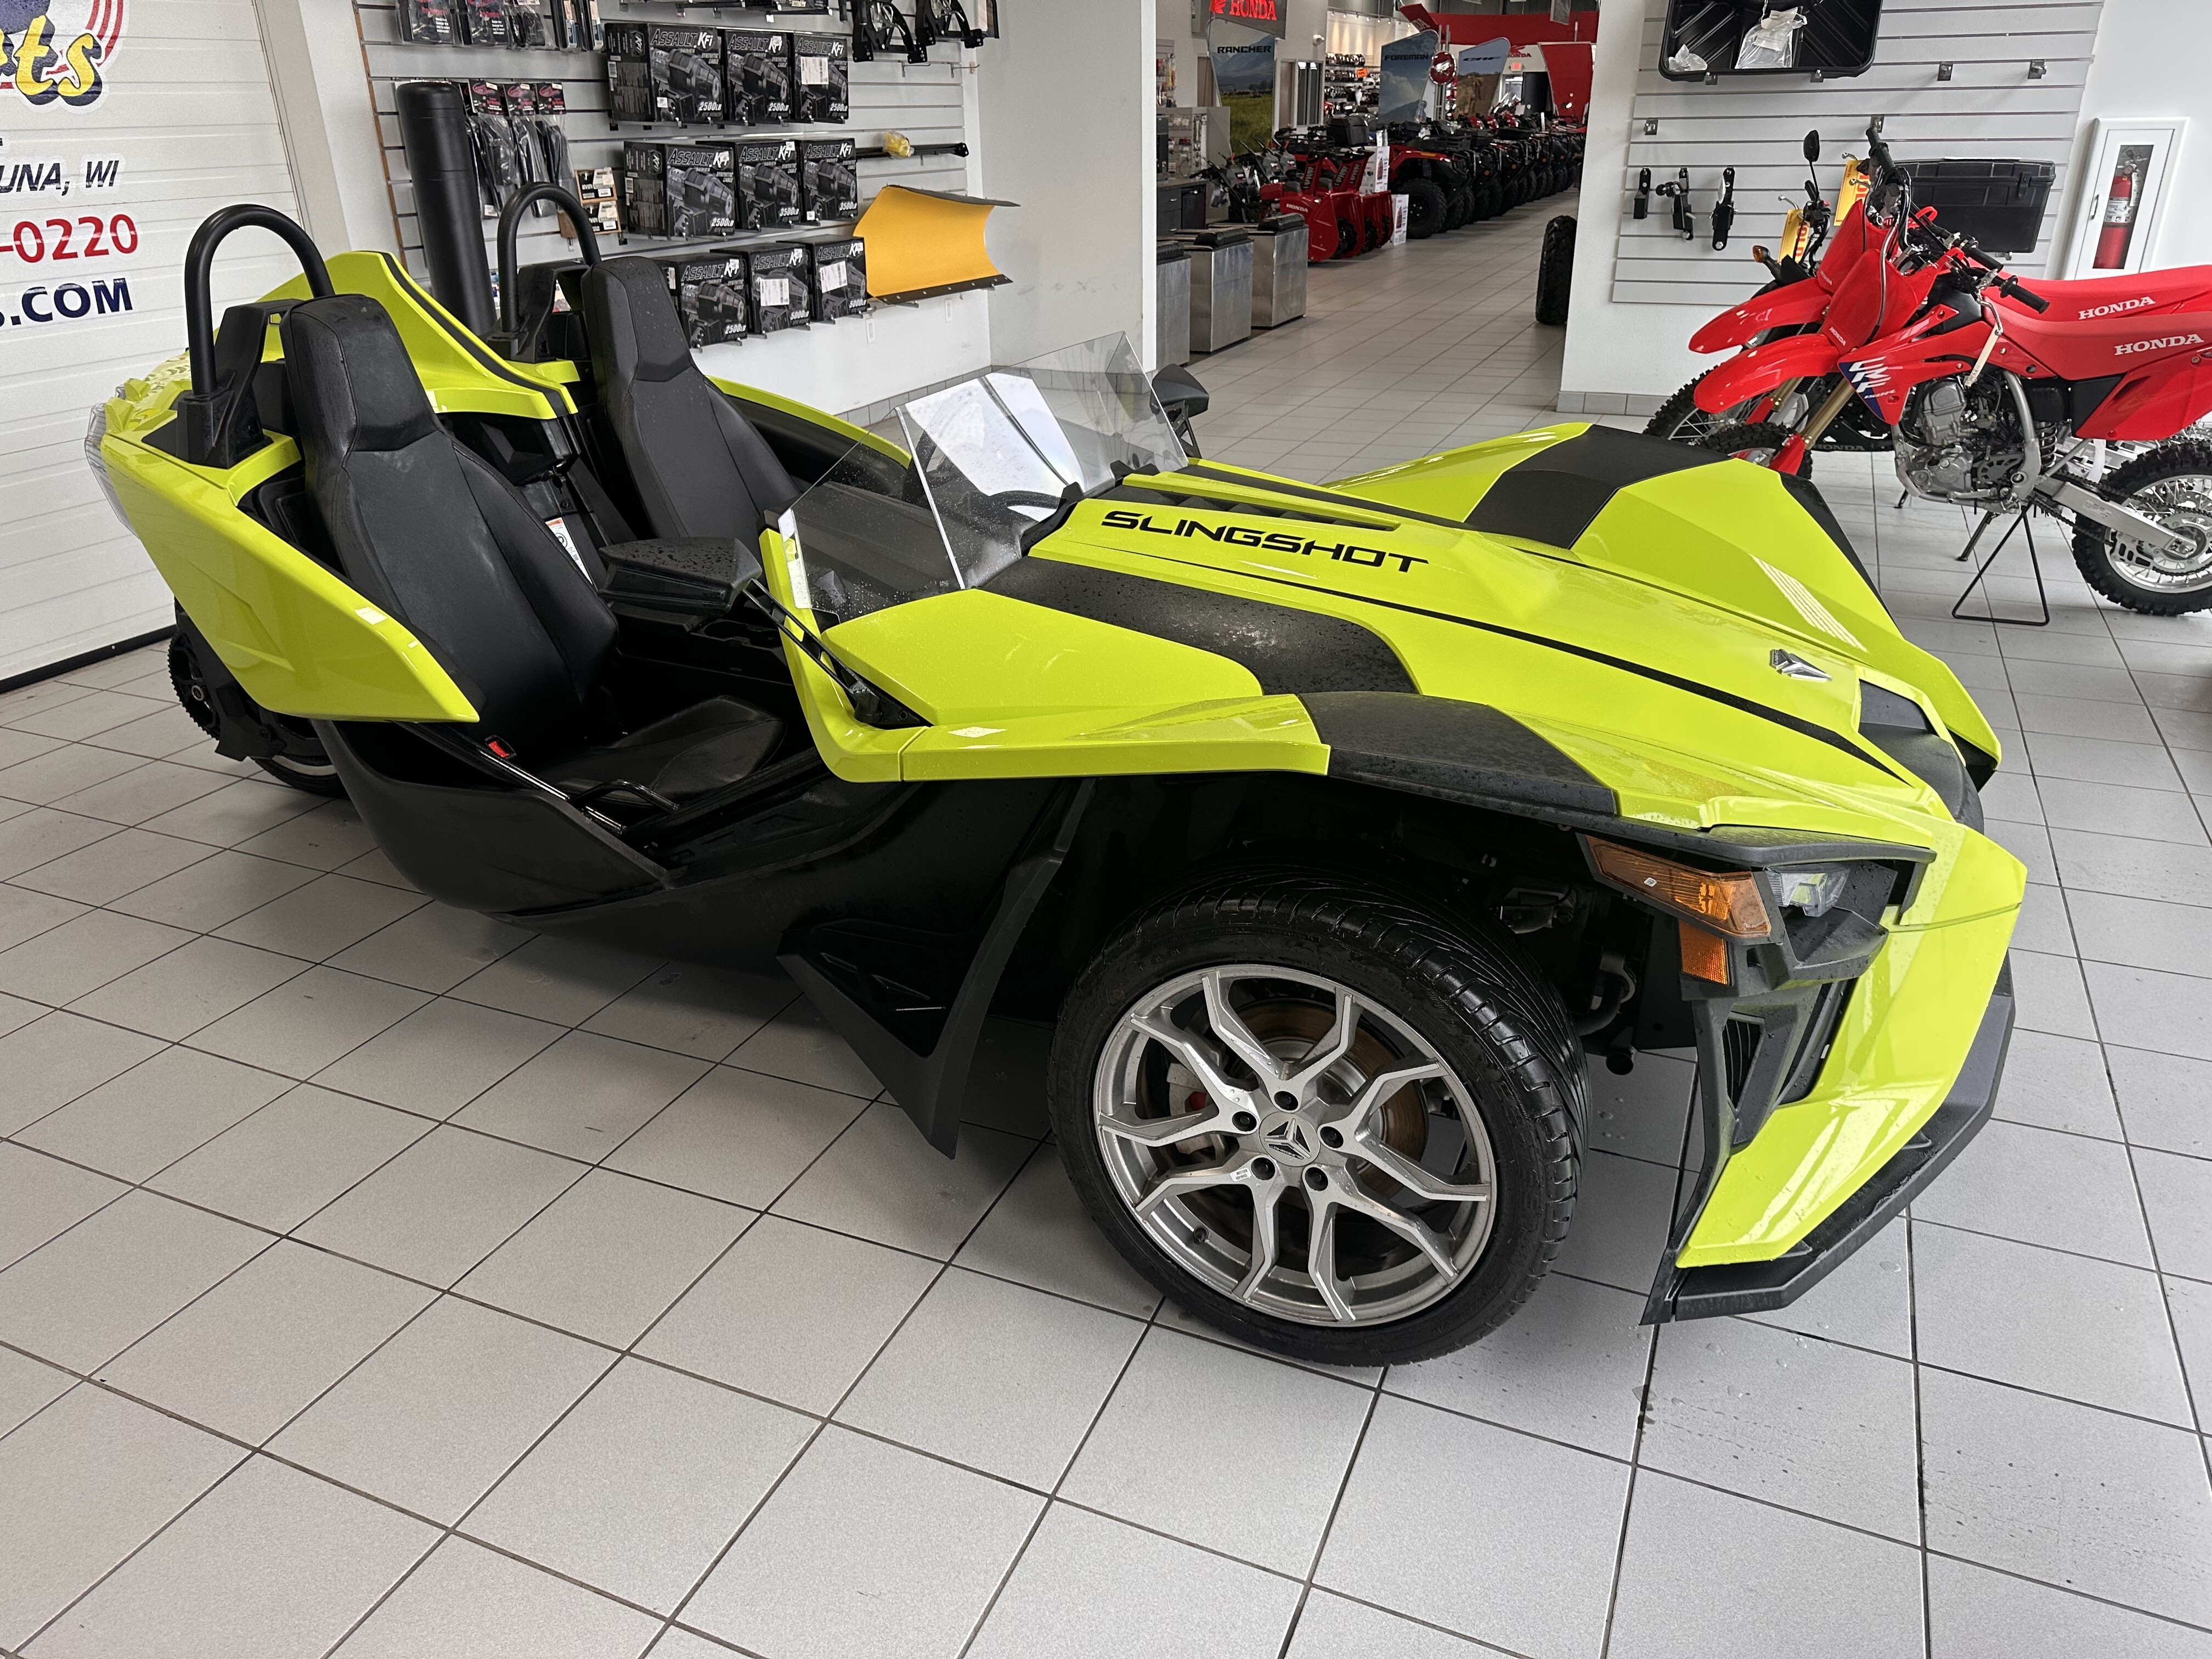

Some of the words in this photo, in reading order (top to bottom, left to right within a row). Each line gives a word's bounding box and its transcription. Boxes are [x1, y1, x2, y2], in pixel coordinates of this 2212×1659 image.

[1229, 0, 1277, 21] HONDA
[651, 29, 698, 47] ASSAULT
[728, 34, 768, 52] ASSAULT
[796, 38, 832, 54] ASSAULT
[0, 15, 100, 102] ts
[1217, 46, 1272, 54] RANCHER
[667, 149, 713, 166] ASSAULT
[739, 146, 778, 162] ASSAULT
[804, 144, 840, 159] ASSAULT
[85, 160, 120, 188] WI
[1286, 204, 1308, 213] HONDA
[0, 214, 138, 263] -0220
[752, 253, 789, 270] ASSAULT
[816, 246, 850, 261] ASSAULT
[681, 264, 724, 282] ASSAULT
[0, 278, 133, 328] .COM
[2078, 296, 2156, 320] HONDA
[1829, 326, 1847, 346] HONDA
[2114, 334, 2204, 356] HONDA
[1849, 356, 1892, 393] CRF
[1101, 510, 1430, 573] SLINGSHOT
